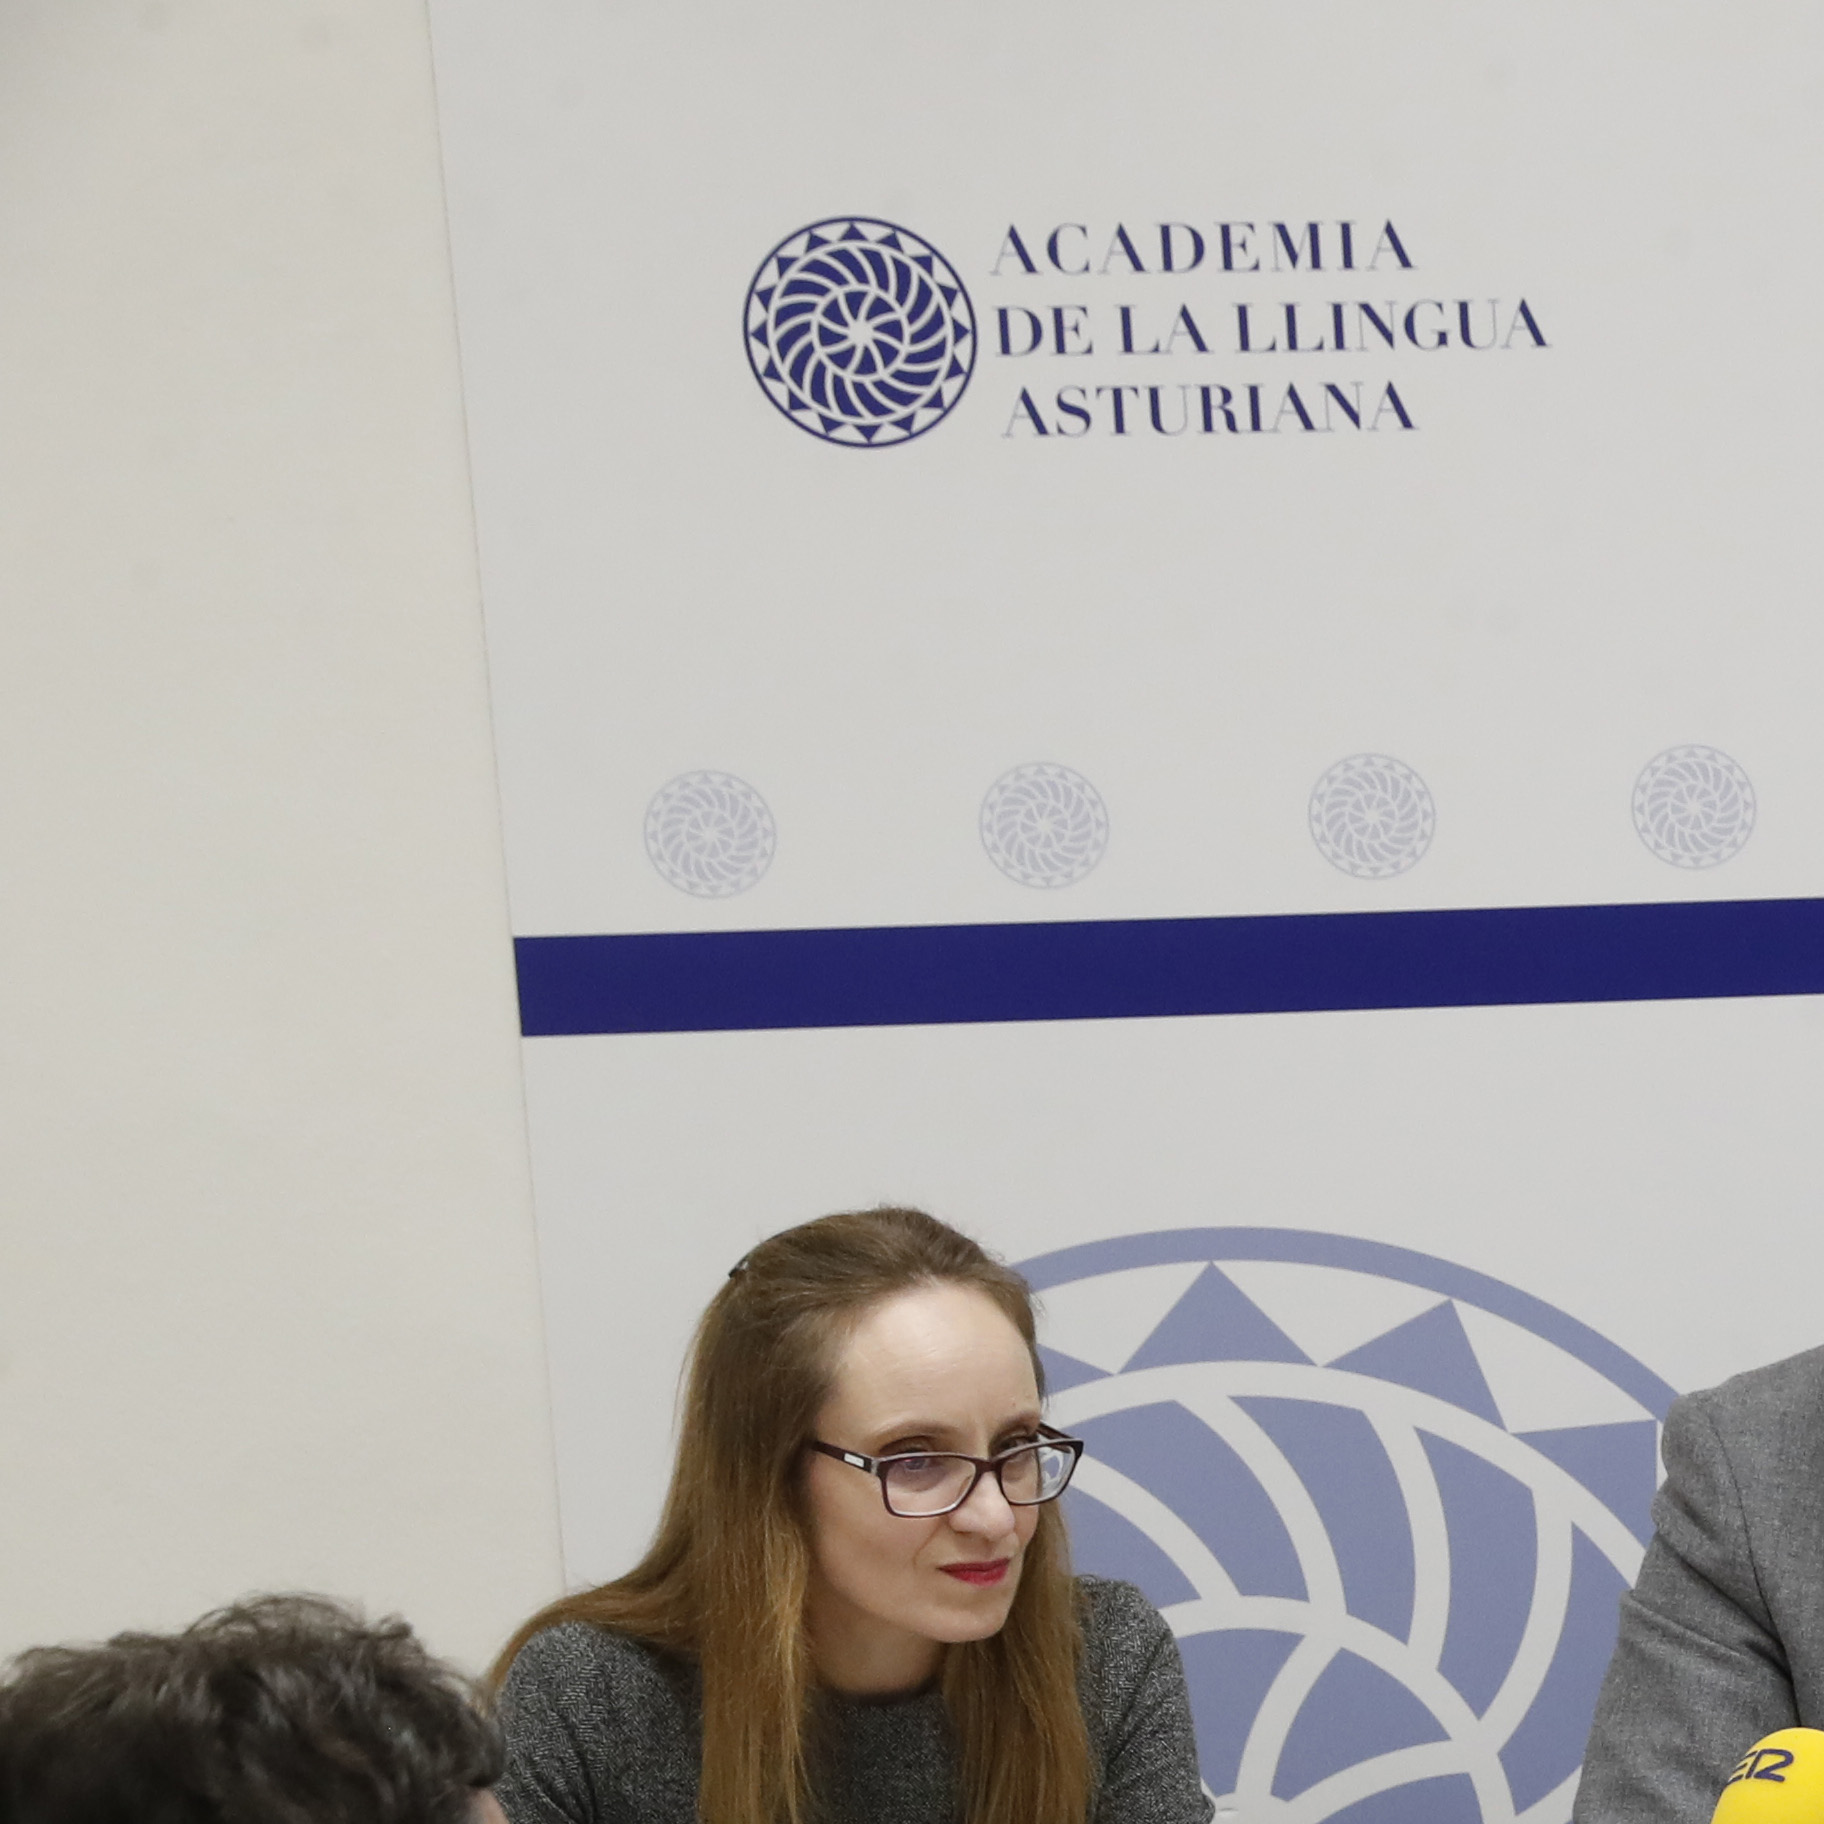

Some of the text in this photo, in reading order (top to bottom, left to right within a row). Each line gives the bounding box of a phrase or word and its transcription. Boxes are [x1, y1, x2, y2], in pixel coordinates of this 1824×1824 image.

[990, 219, 1418, 277] ACADEMIA
[995, 298, 1552, 357] DE LA LLINGUA
[1001, 380, 1419, 438] ASTURIANA
